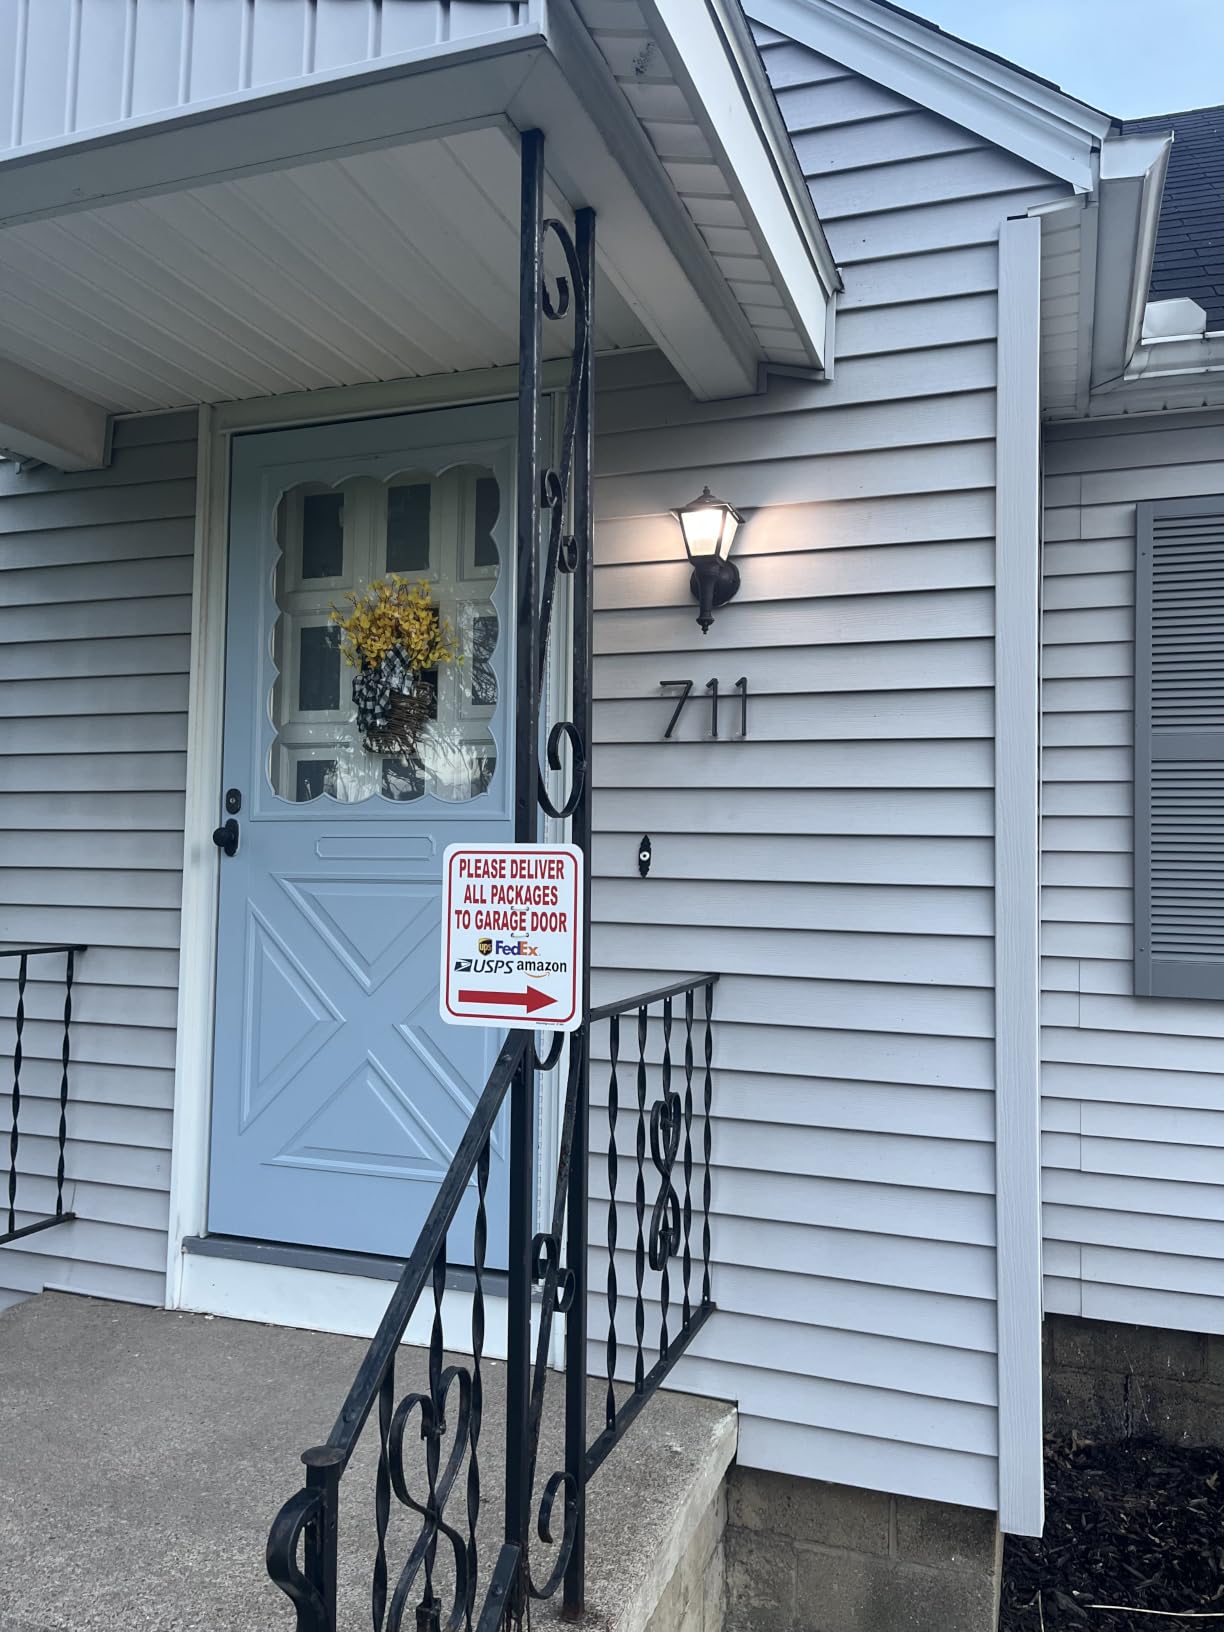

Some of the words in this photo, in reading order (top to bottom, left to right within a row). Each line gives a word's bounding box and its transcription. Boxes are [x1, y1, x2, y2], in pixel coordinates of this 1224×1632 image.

[659, 676, 748, 738] 711
[459, 858, 506, 879] PLEASE
[510, 859, 565, 880] DELIVER
[463, 884, 487, 904] ALL
[491, 885, 558, 906] PACKAGES
[455, 909, 471, 930] TO
[475, 910, 527, 932] GARAGE
[531, 911, 567, 933] DOOR
[495, 940, 539, 956] FedEx
[473, 959, 514, 974] USPS
[516, 960, 567, 973] amazon
